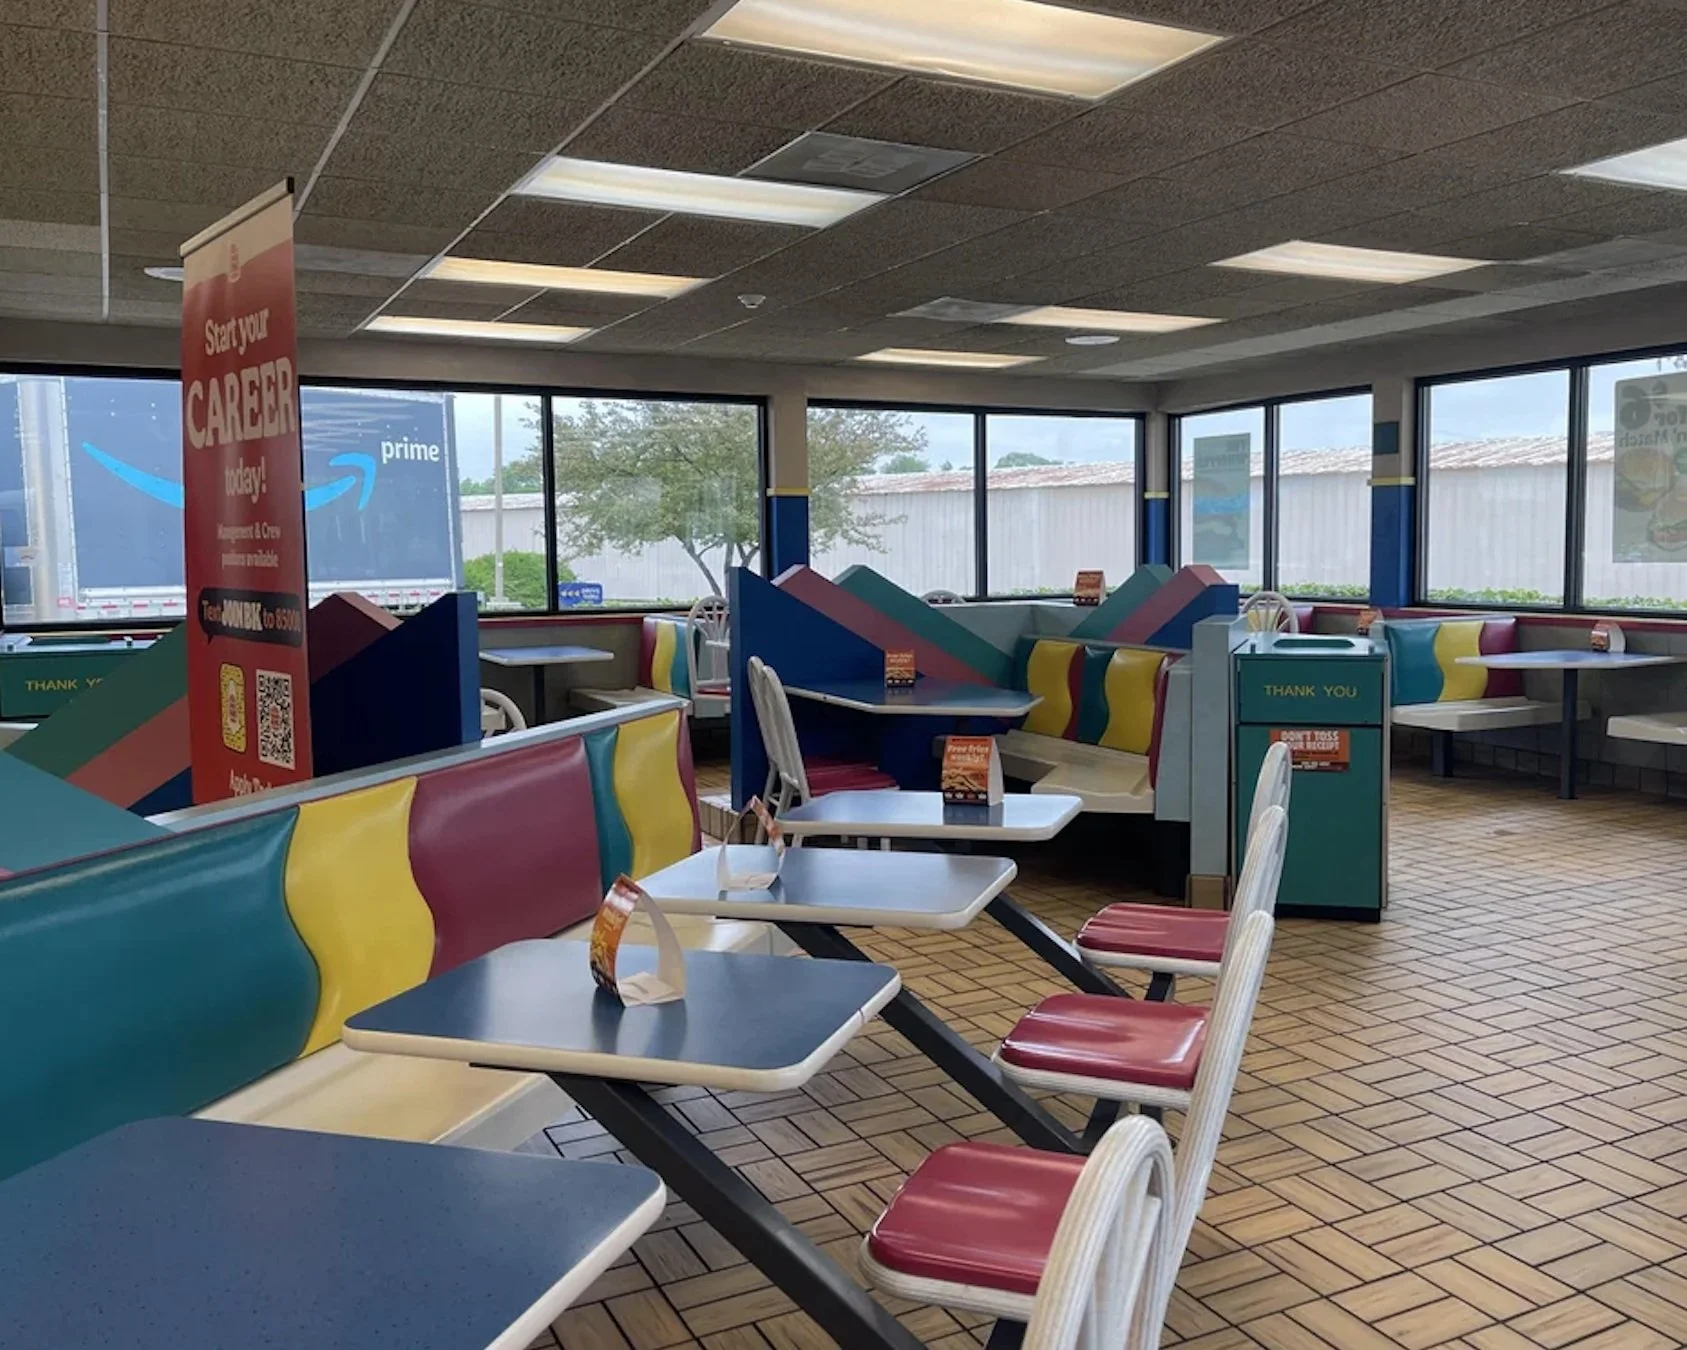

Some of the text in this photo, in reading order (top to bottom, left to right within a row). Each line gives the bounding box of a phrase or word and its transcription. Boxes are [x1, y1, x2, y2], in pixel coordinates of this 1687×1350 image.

[205, 307, 269, 356] Start your
[186, 356, 296, 450] CAREER
[381, 436, 440, 465] prime
[224, 456, 267, 504] today!
[254, 521, 262, 540] &
[202, 600, 222, 622] Text
[262, 607, 275, 629] to
[25, 679, 78, 692] THANK
[1264, 684, 1357, 699] THANK YOU
[1287, 741, 1340, 751] OUR RECEIPT
[1313, 730, 1340, 742] TOSS
